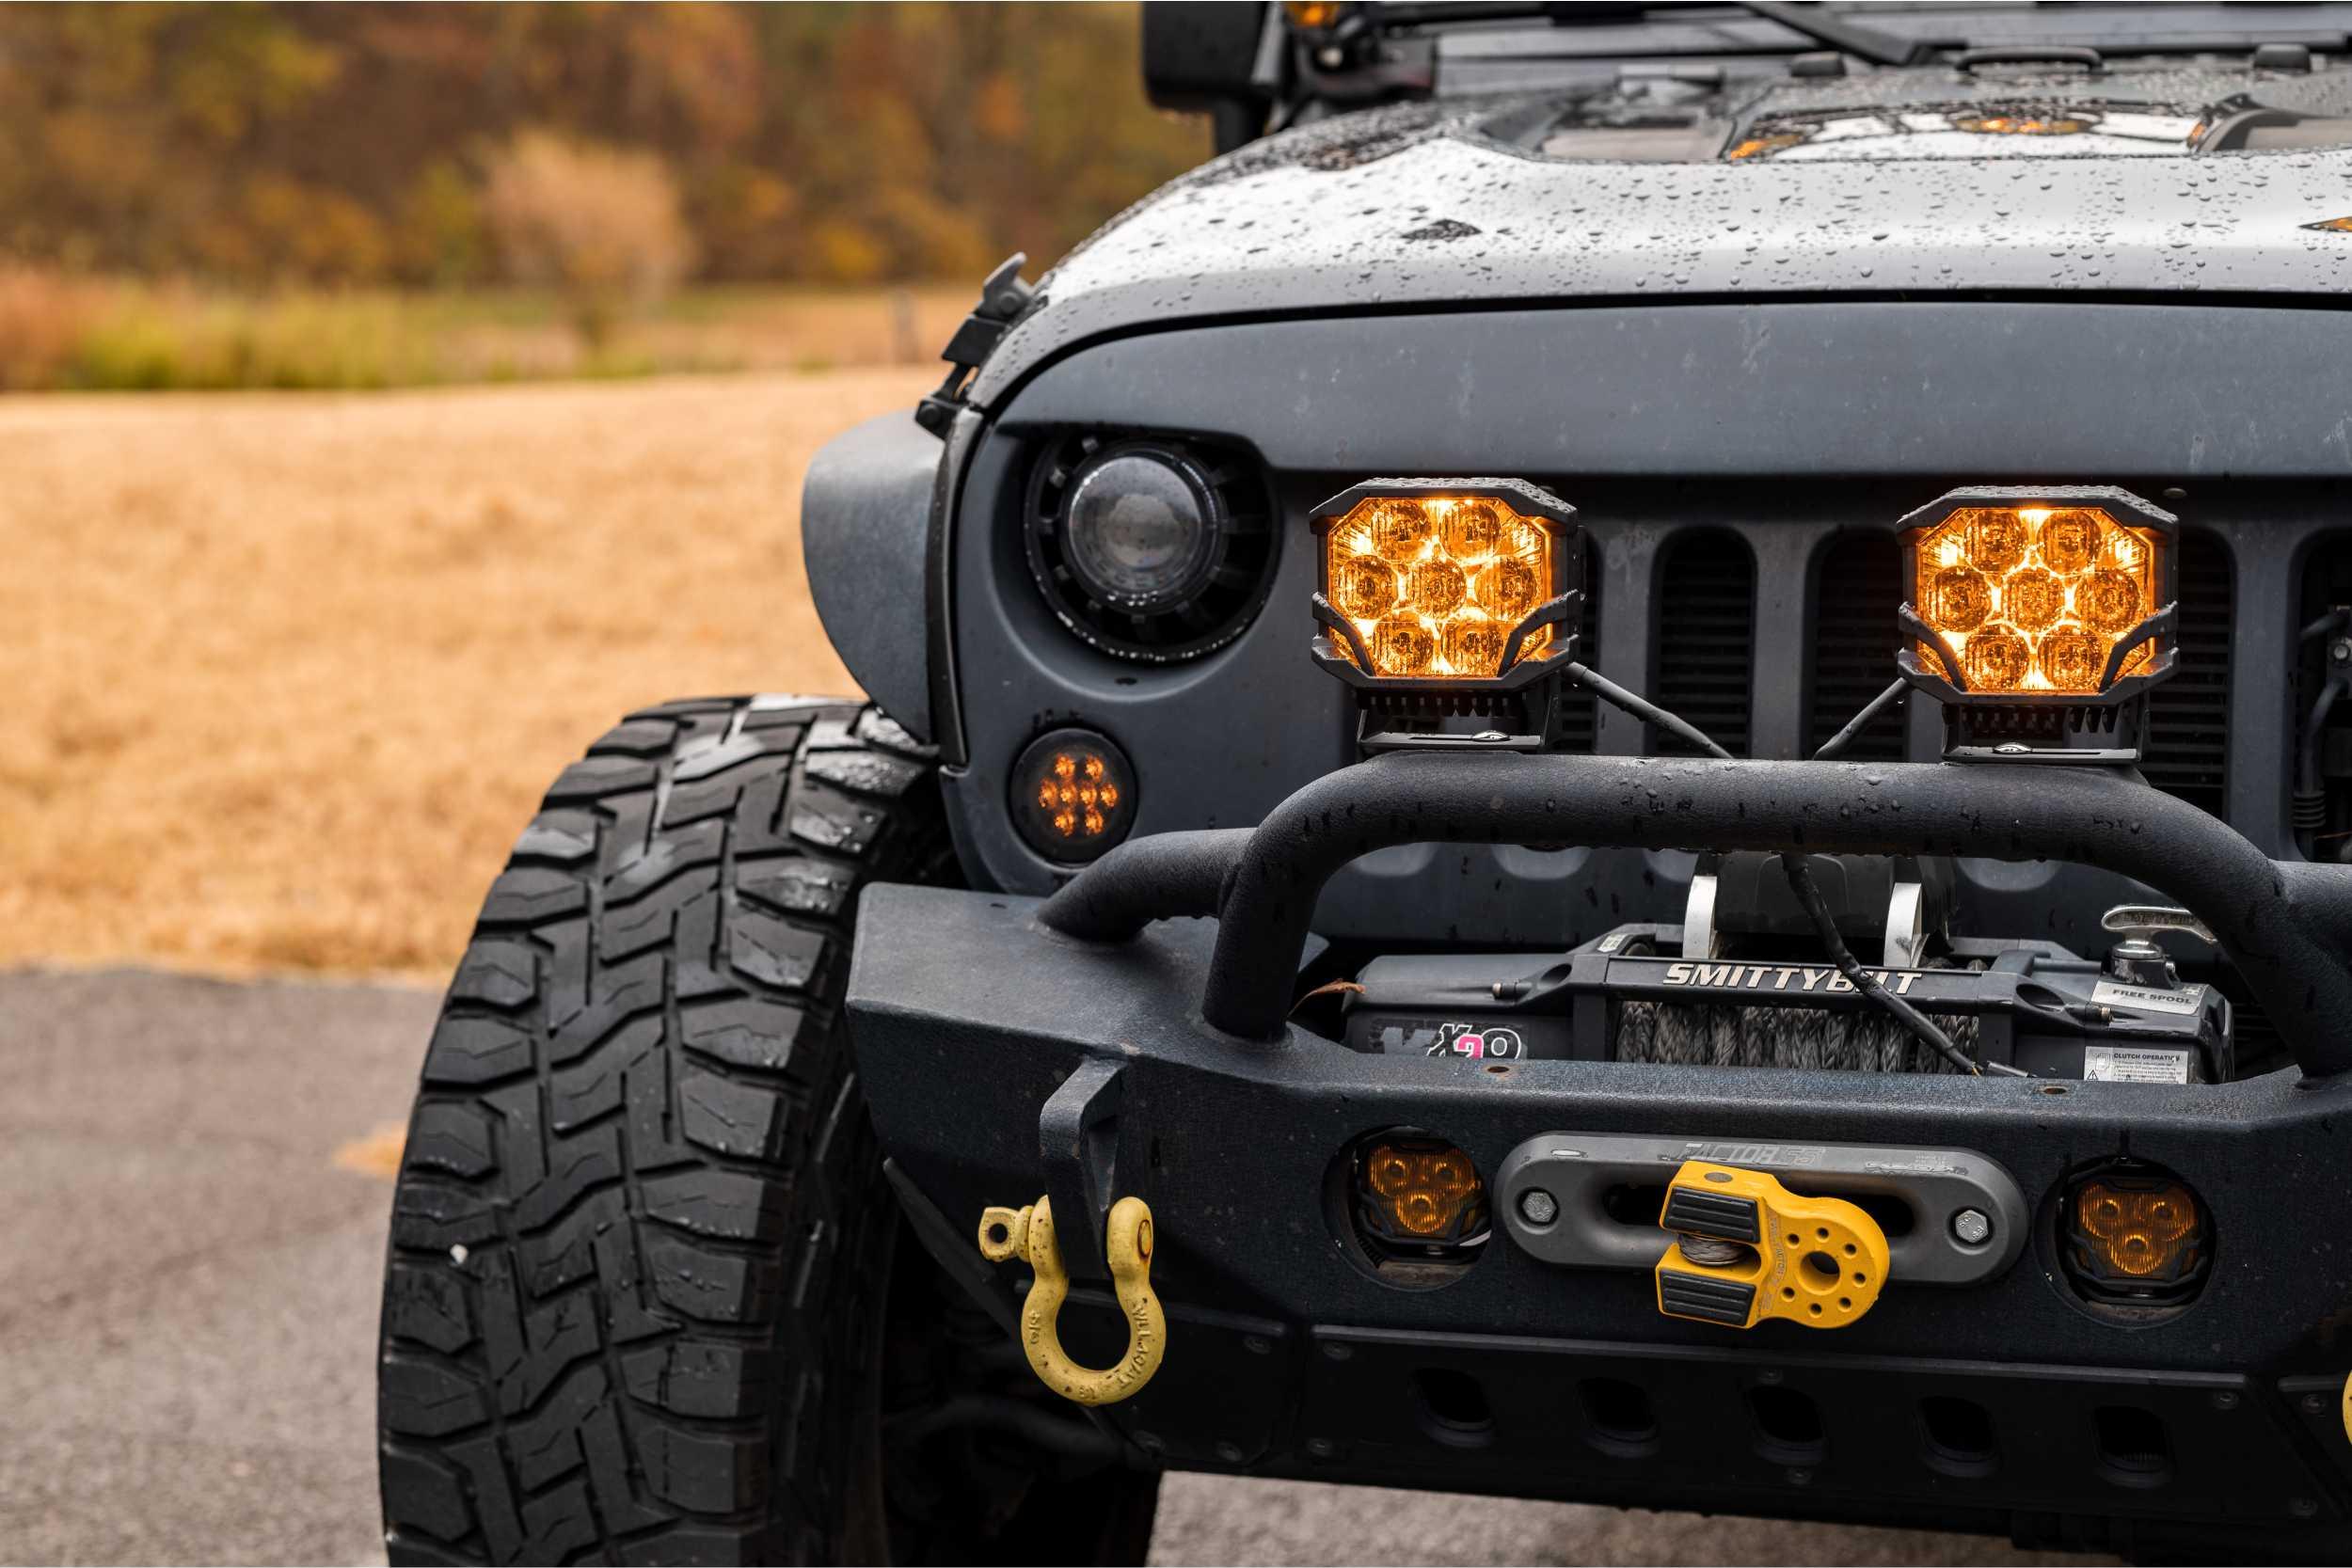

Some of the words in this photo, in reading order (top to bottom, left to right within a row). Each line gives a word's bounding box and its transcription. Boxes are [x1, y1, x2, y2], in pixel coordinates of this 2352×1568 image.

[1662, 963, 1922, 994] SMITTYBT
[2112, 989, 2146, 999] FREE
[2150, 994, 2192, 1004] SPOOL
[2113, 1053, 2140, 1061] CLUTCH
